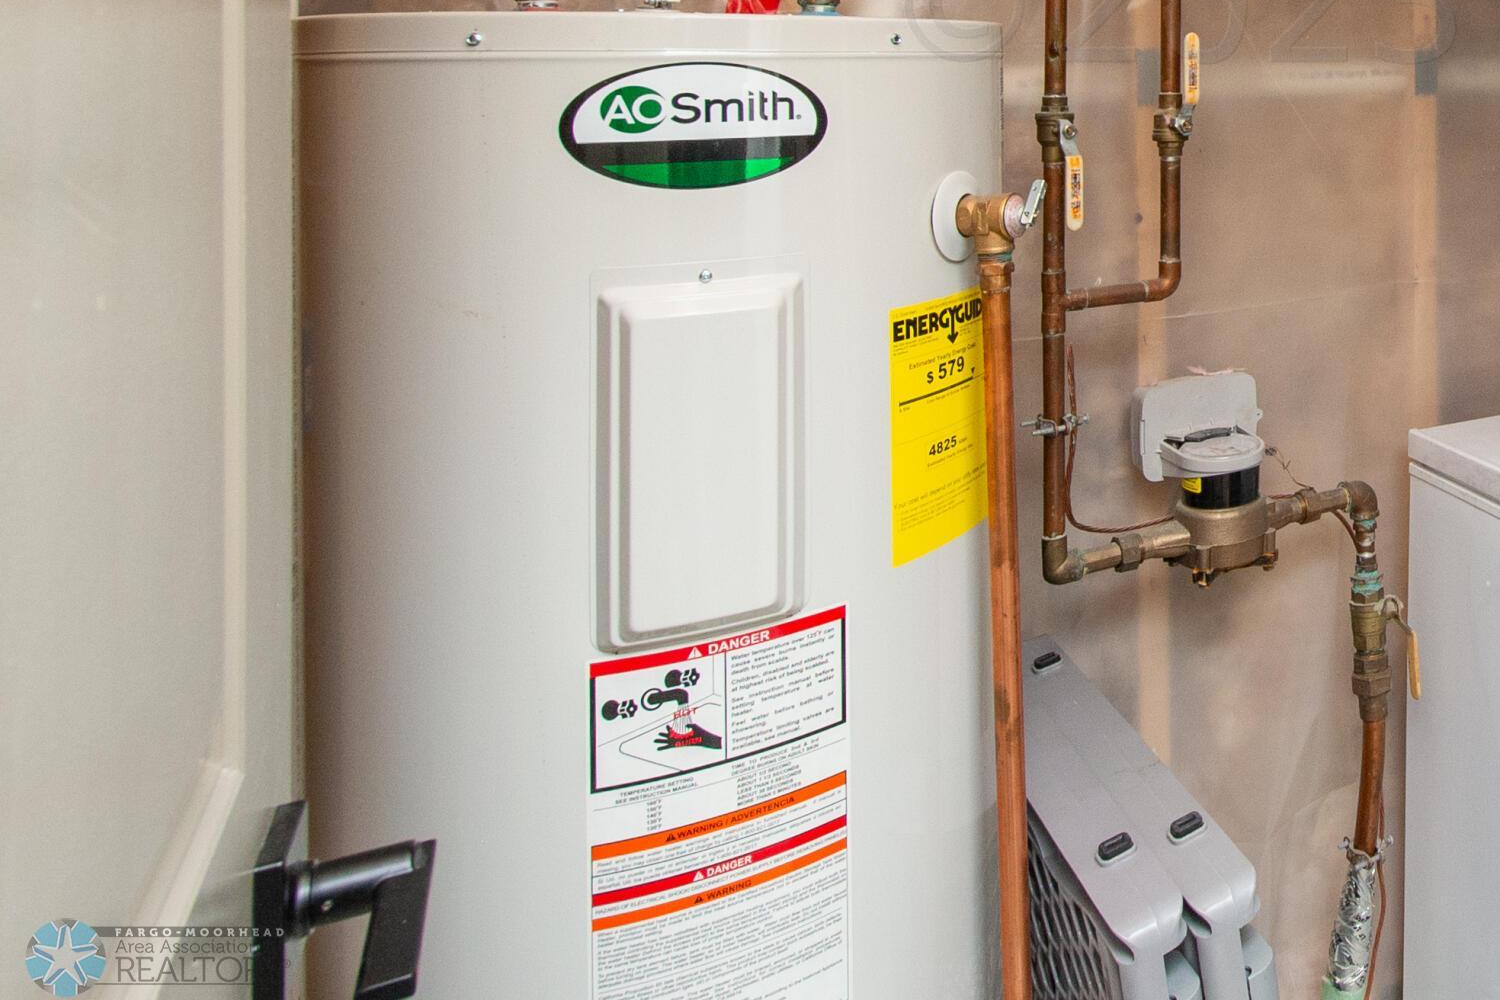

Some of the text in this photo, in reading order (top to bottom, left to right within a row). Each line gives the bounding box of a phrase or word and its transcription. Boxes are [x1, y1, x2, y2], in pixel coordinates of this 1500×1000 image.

[671, 89, 798, 125] Smith
[893, 298, 983, 343] ENERGYGUID
[938, 355, 965, 380] 579
[928, 435, 957, 457] 4825
[708, 630, 770, 655] DANGER
[677, 820, 724, 840] WARNING
[730, 796, 795, 824] ADVERTENCIA
[706, 855, 752, 878] DANGER
[707, 879, 752, 900] WARNING
